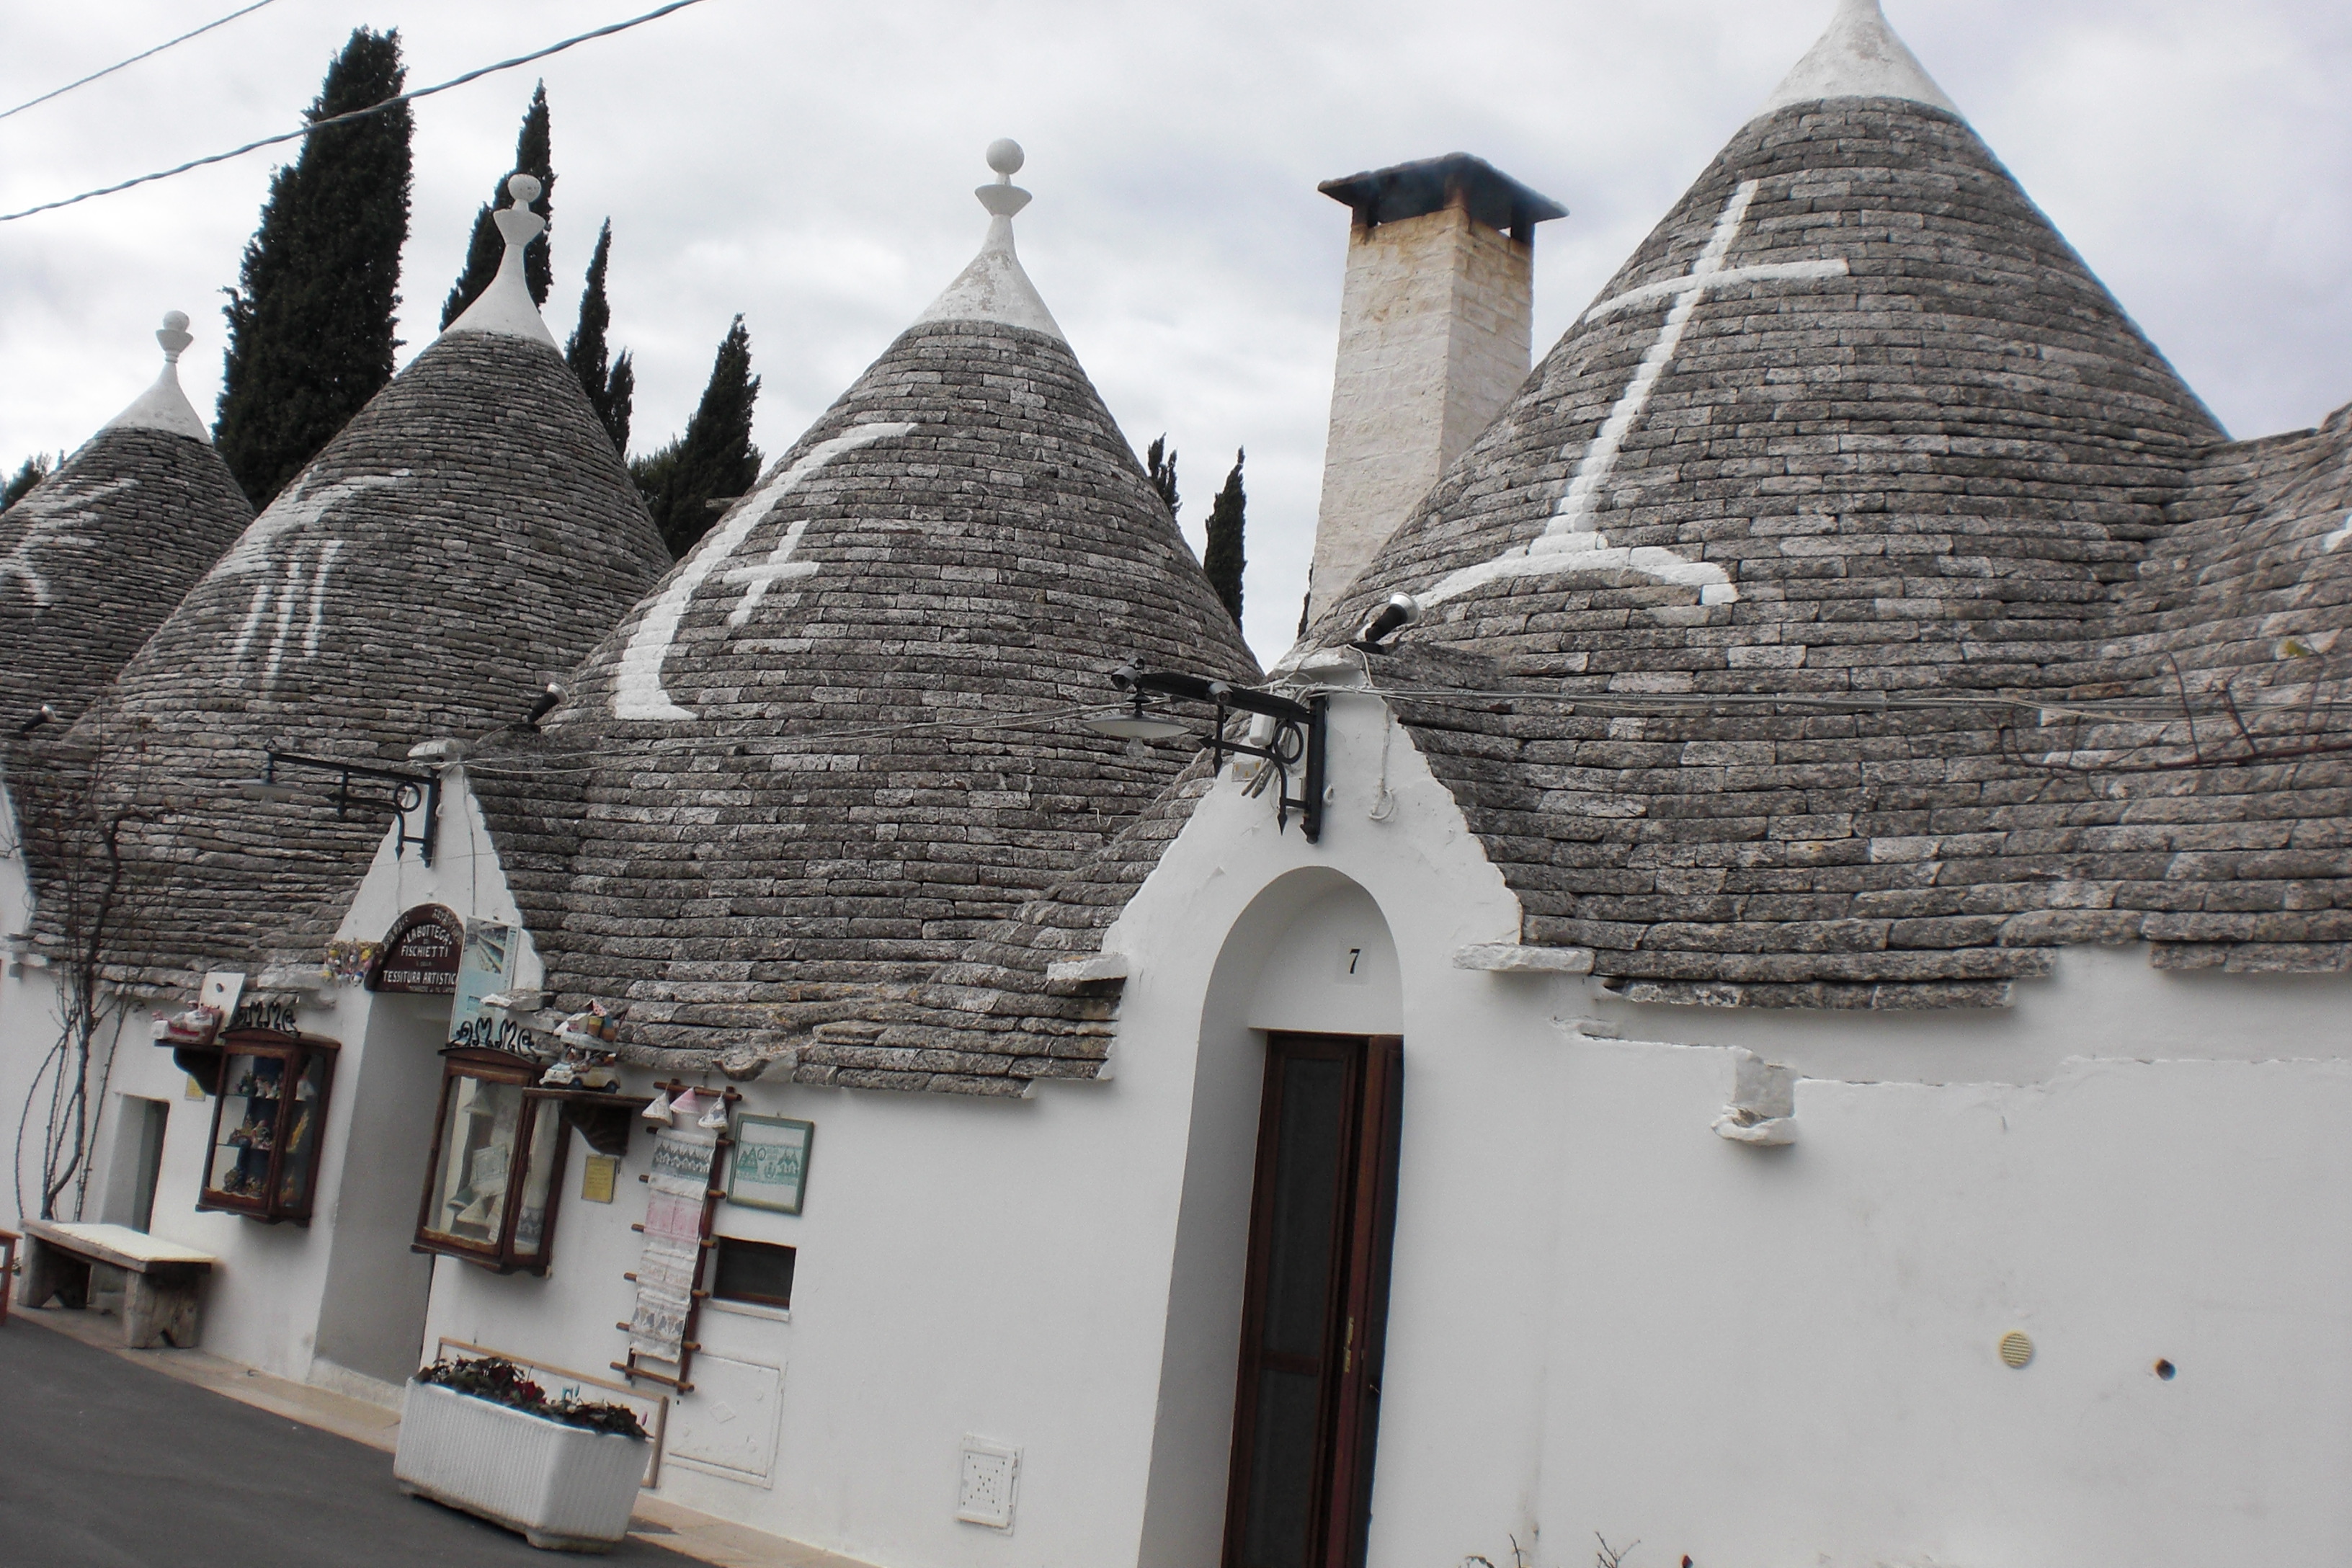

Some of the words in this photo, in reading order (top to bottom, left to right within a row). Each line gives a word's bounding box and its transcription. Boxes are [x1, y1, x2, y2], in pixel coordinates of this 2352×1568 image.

[401, 945, 449, 958] FISCHIETTI
[1350, 948, 1361, 974] 7
[383, 970, 421, 984] TESSITURA
